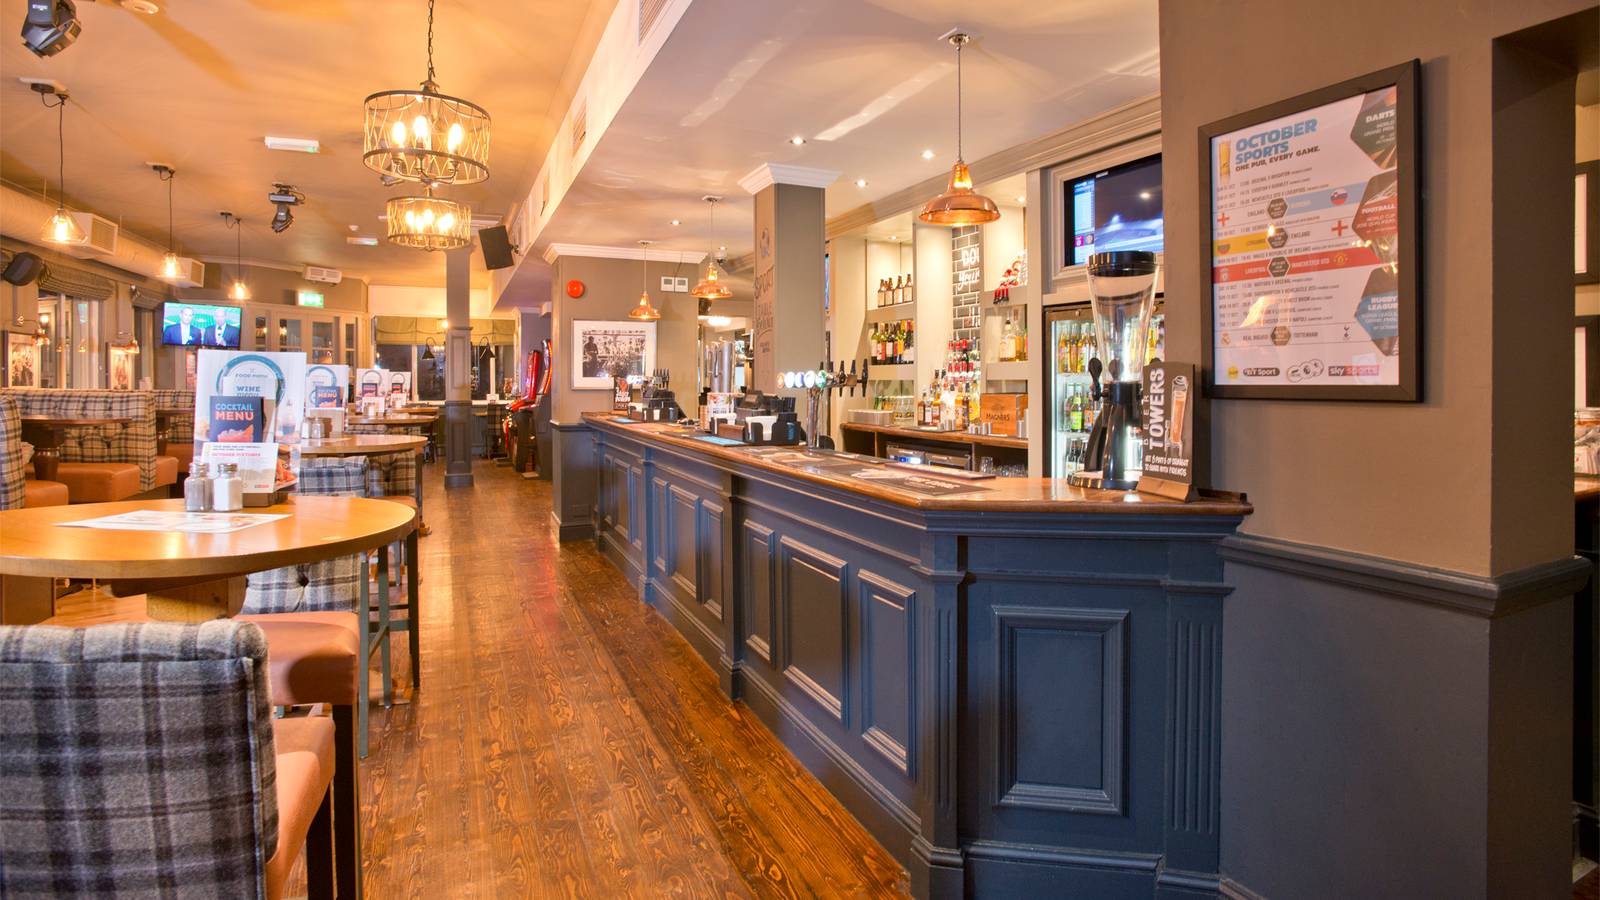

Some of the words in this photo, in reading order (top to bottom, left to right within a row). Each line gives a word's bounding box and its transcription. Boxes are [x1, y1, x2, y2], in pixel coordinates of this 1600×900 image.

[1366, 110, 1395, 123] DARTS
[1236, 118, 1318, 152] OCTOBER
[1235, 141, 1289, 165] SPORTS
[1235, 164, 1250, 172] ONE
[1269, 152, 1294, 163] EVERY
[1258, 368, 1276, 376] Sport
[216, 412, 254, 420] MENU
[1150, 368, 1165, 450] TOWERS
